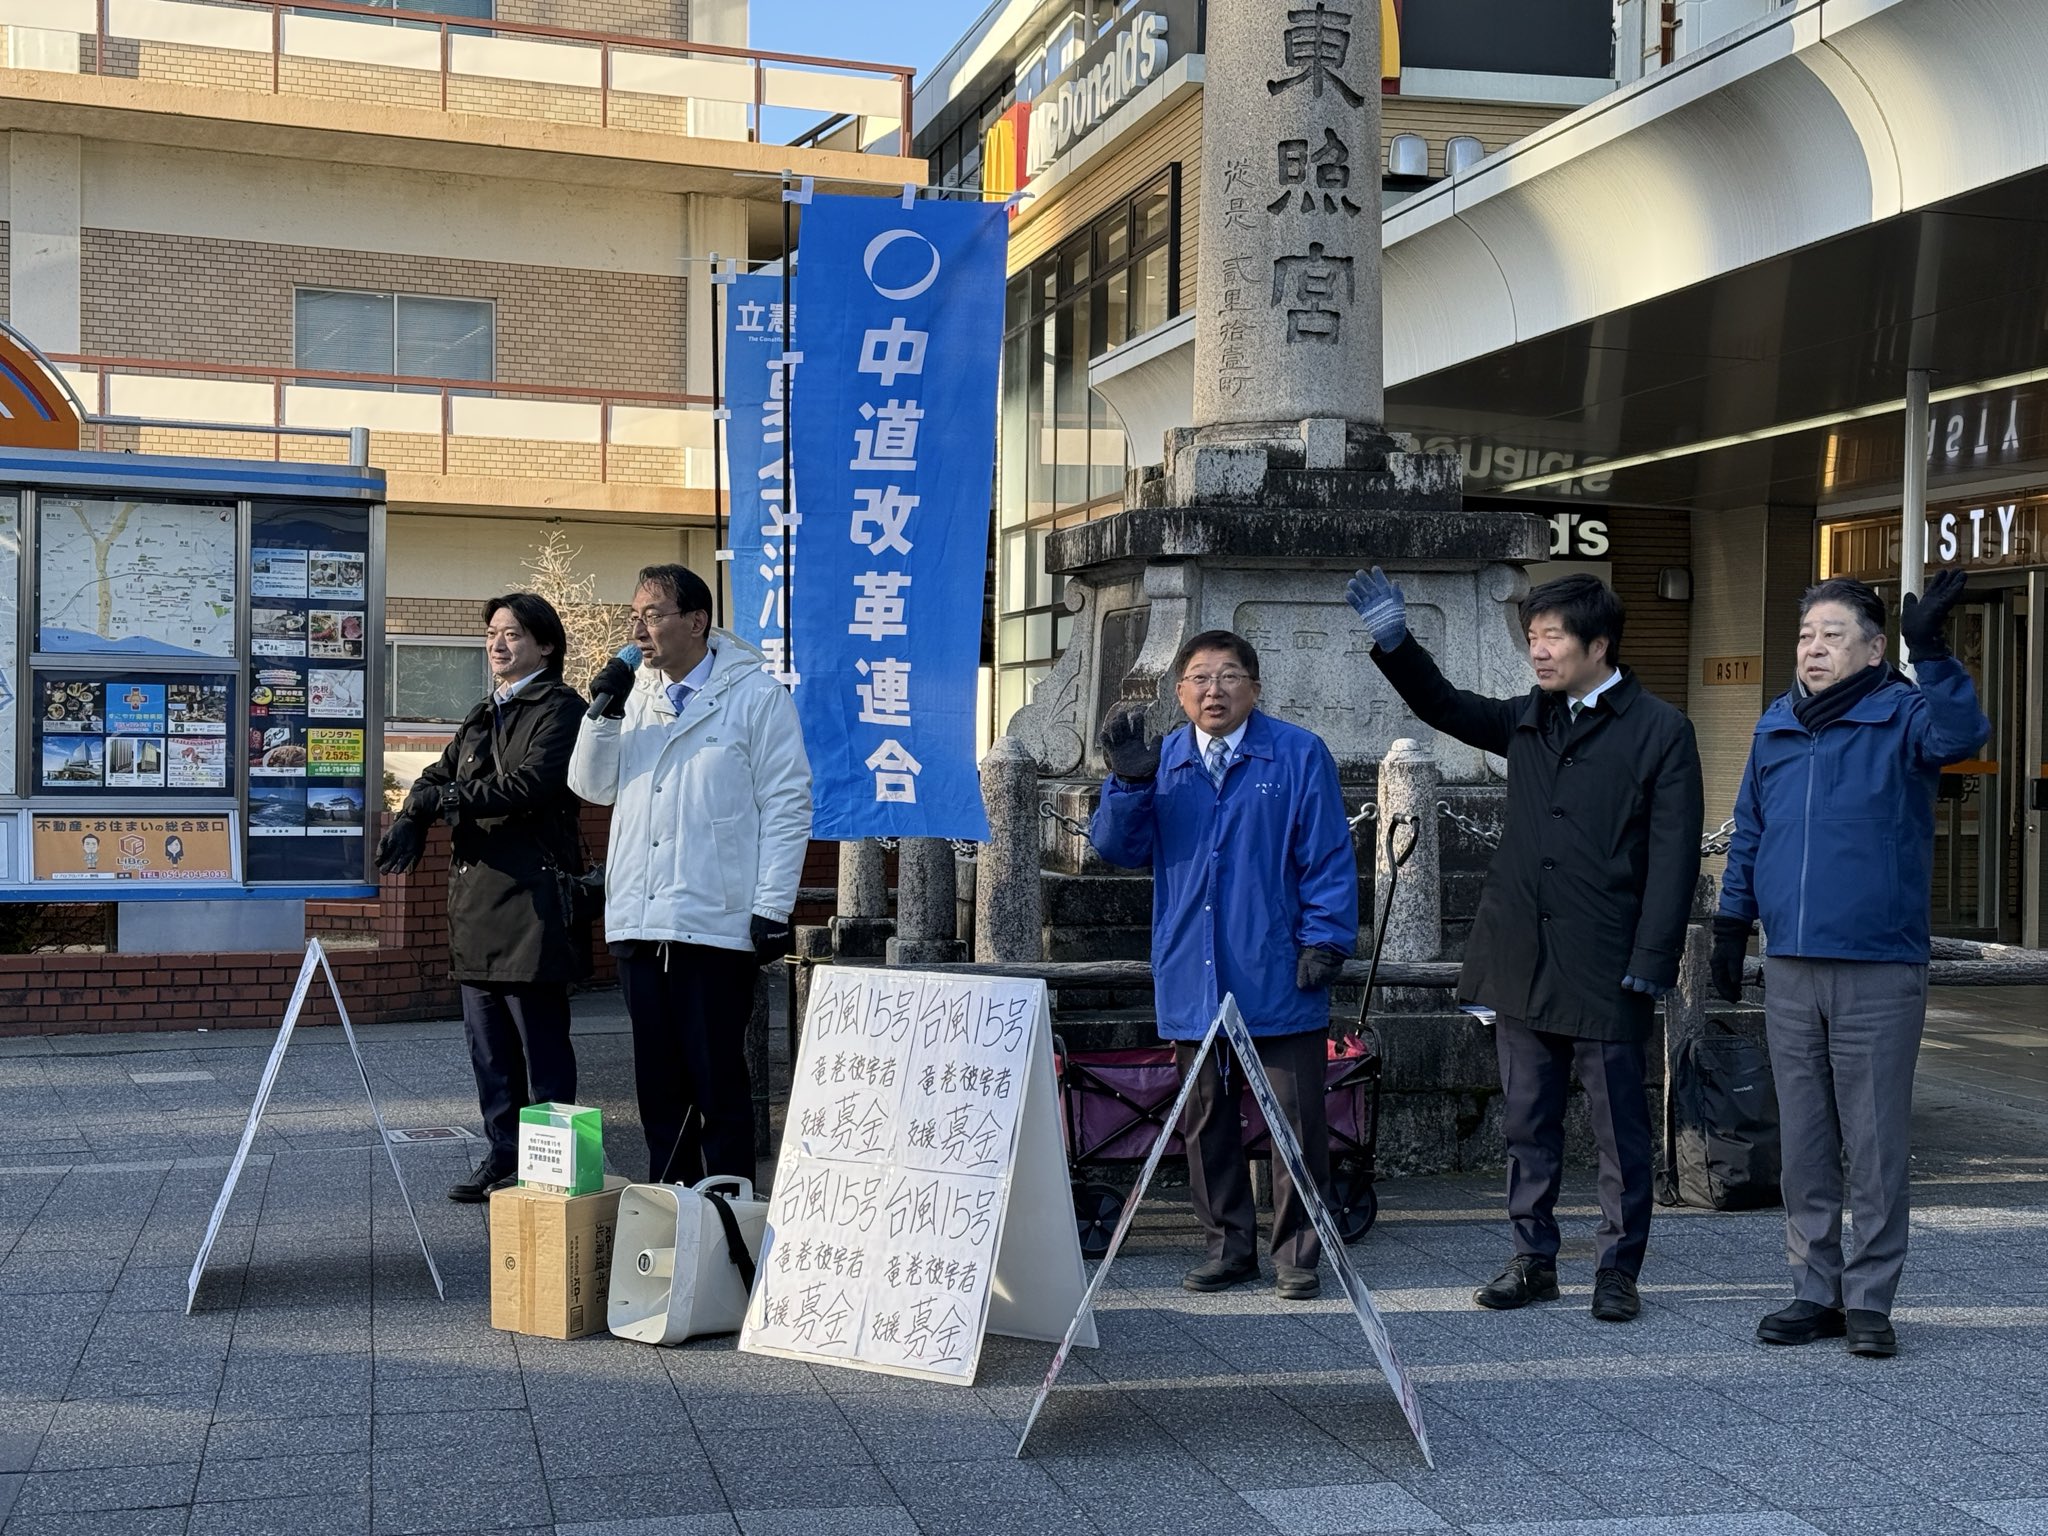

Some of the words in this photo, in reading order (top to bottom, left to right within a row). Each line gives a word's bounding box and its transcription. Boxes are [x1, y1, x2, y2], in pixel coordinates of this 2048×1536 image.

[1025, 10, 1169, 178] McDonald's
[1266, 2, 1365, 346] 東照宮
[849, 317, 929, 803] 中道改革連合
[1717, 661, 1749, 680] ASTY
[36, 820, 225, 832] 不動産・お住まいの総合窓口
[140, 871, 159, 879] TEL
[815, 979, 915, 1043] 台風15号
[919, 989, 1027, 1053] 台風15号
[810, 1050, 897, 1088] 竜巻被害者
[917, 1061, 1013, 1100] 竜巻被害者
[778, 1165, 882, 1234] 台風15号
[884, 1176, 995, 1246] 台風15号
[774, 1240, 865, 1279] 竜巻被害者
[883, 1251, 978, 1294] 竜巻被害者
